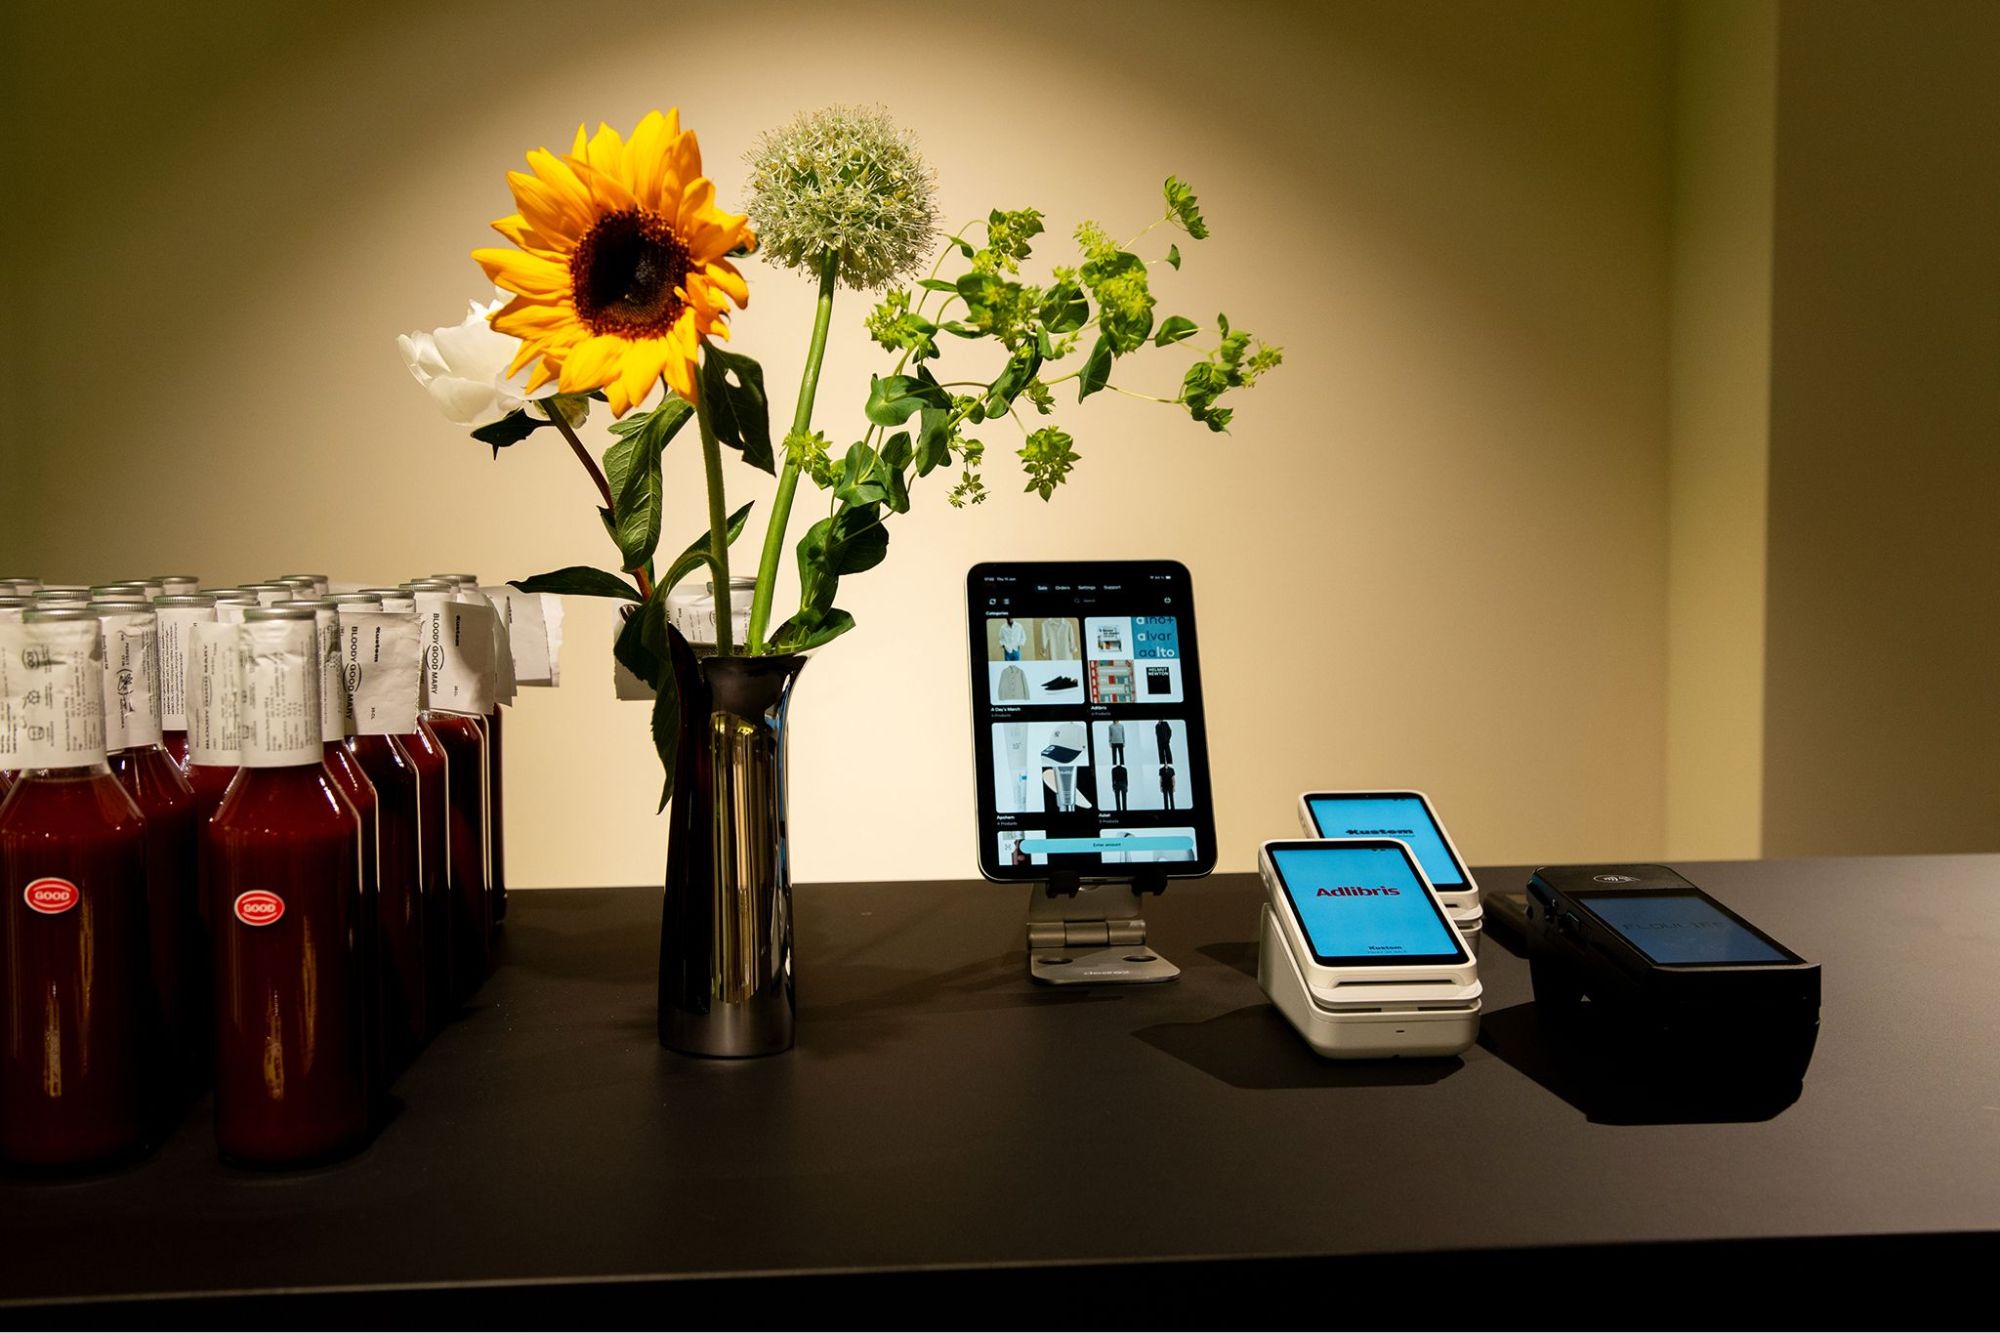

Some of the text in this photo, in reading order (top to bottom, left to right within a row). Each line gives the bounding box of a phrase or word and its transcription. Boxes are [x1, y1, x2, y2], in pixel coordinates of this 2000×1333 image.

[432, 613, 440, 644] BLOODY
[1138, 631, 1172, 641] alvar
[1138, 646, 1175, 657] aalto
[346, 626, 358, 720] BLOODY GOOD MARY
[34, 891, 70, 900] GOOD
[1316, 886, 1400, 897] Adlibris
[243, 904, 276, 913] GOOD
